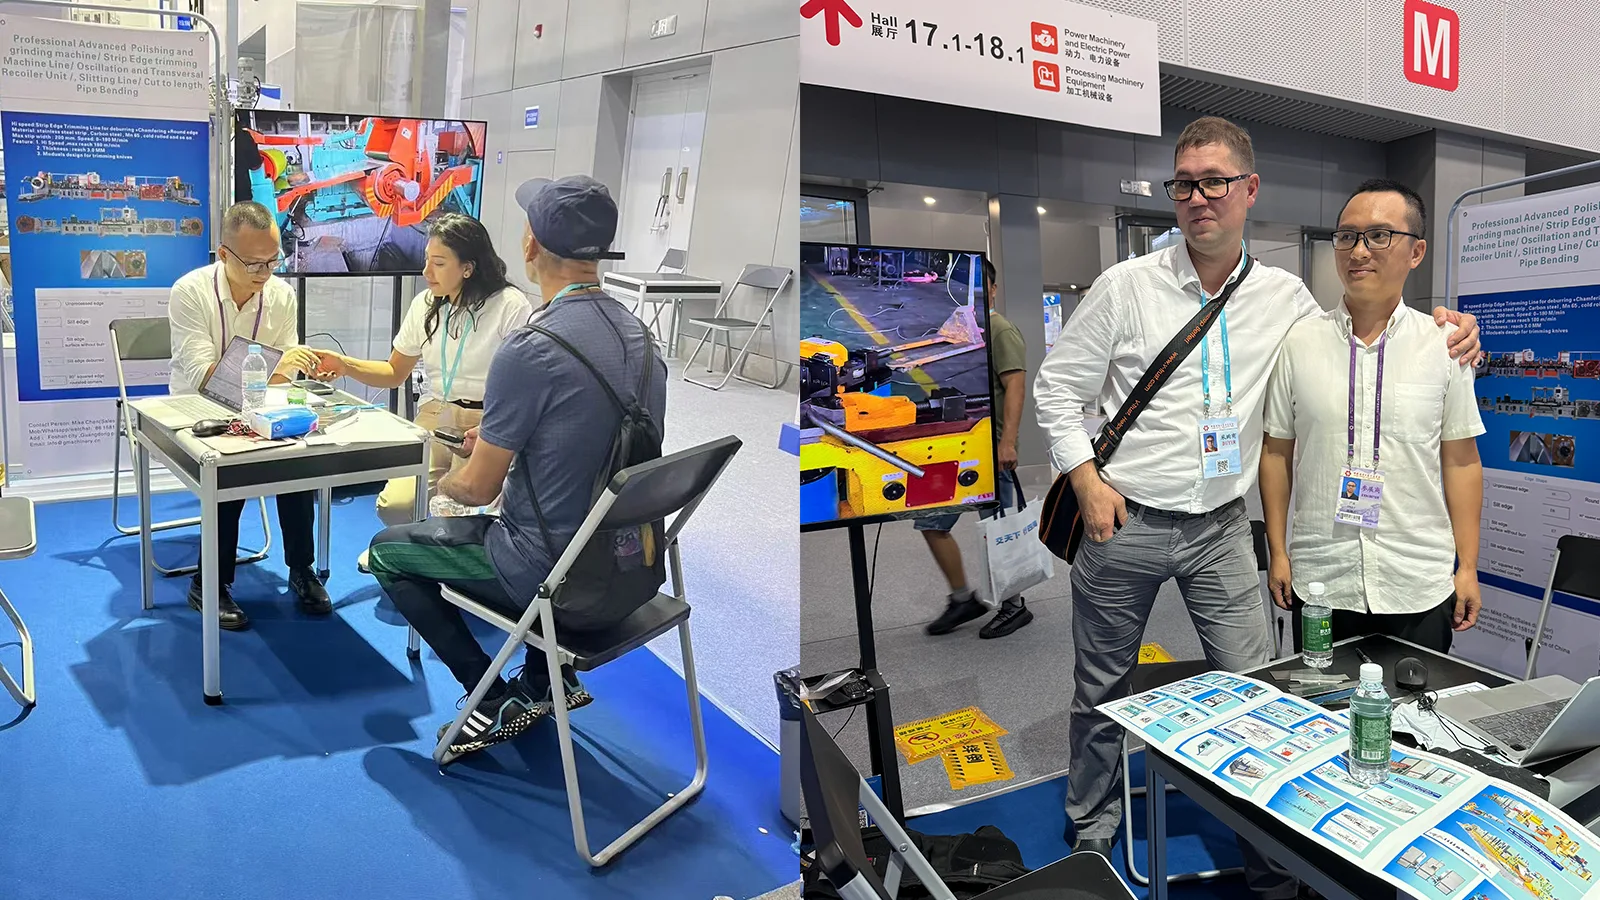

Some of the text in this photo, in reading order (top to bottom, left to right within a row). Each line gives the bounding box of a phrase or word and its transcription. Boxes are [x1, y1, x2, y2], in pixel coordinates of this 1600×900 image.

[870, 12, 898, 28] Hall
[871, 24, 898, 40] 展厅
[905, 18, 1024, 64] 17.1-18.1
[1064, 28, 1126, 50] Power Machinery
[14, 34, 76, 47] Professional
[78, 40, 126, 51] Advanced
[132, 44, 174, 56] Polishing
[1065, 40, 1130, 58] and Electric Power
[1414, 10, 1450, 79] M
[4, 57, 46, 67] Machine
[49, 60, 74, 70] Line/
[77, 62, 128, 73] Oscillation
[151, 68, 203, 78] Transversal
[10, 46, 197, 69] grinding machine/ Strip Edge trimming
[2, 68, 43, 78] Recoiler
[46, 71, 67, 80] Unit
[80, 74, 115, 85] Slitting
[118, 76, 141, 86] Line/
[144, 78, 160, 86] Cut
[174, 80, 205, 90] length,
[1066, 66, 1144, 89] Processing Machinery
[1066, 76, 1106, 90] Equipment
[77, 84, 138, 97] Pipe Bending
[1066, 86, 1113, 102] 加工机械设备
[1472, 214, 1522, 230] Professional
[1524, 206, 1569, 221] Advanced
[1463, 227, 1591, 252] Machine Line/ Oscillation and
[1468, 216, 1596, 243] grinding machine/ Strip Edge
[1461, 253, 1492, 263] Recoiler
[1495, 250, 1512, 259] Unit
[1522, 245, 1556, 256] Slitting
[1558, 240, 1583, 251] Line/
[1520, 254, 1579, 268] Pipe Bending
